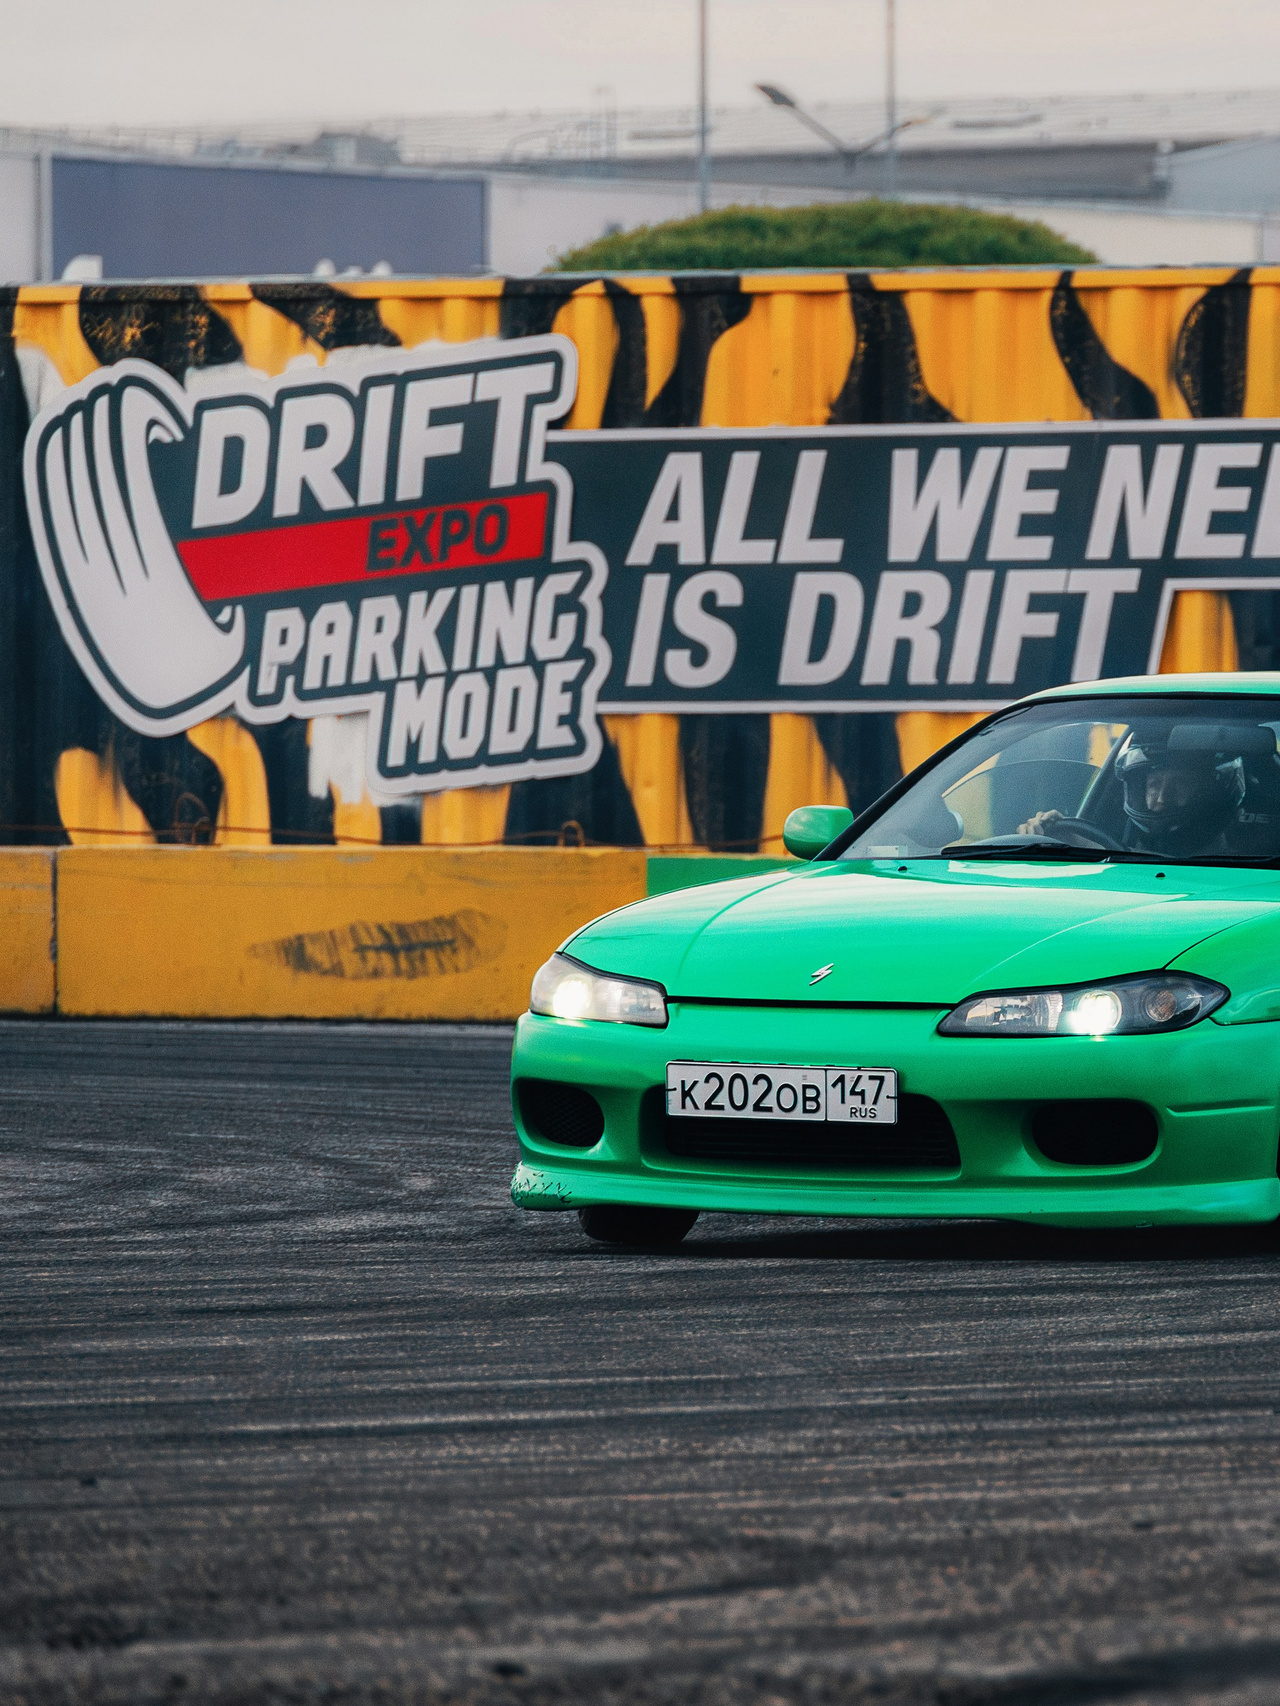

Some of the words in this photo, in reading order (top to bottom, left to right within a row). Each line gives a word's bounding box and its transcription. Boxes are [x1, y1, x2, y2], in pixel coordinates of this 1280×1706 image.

[191, 362, 555, 529] DRIFT
[365, 504, 509, 572] EXPO
[624, 450, 844, 565] ALL
[888, 446, 1070, 562] WE
[256, 570, 585, 695] PARKING
[625, 570, 744, 688] IS
[777, 568, 1142, 685] DRIFT
[386, 660, 585, 768] MODE
[680, 1072, 821, 1114] К202ОВ
[831, 1074, 885, 1105] 147
[850, 1107, 877, 1119] RUS
